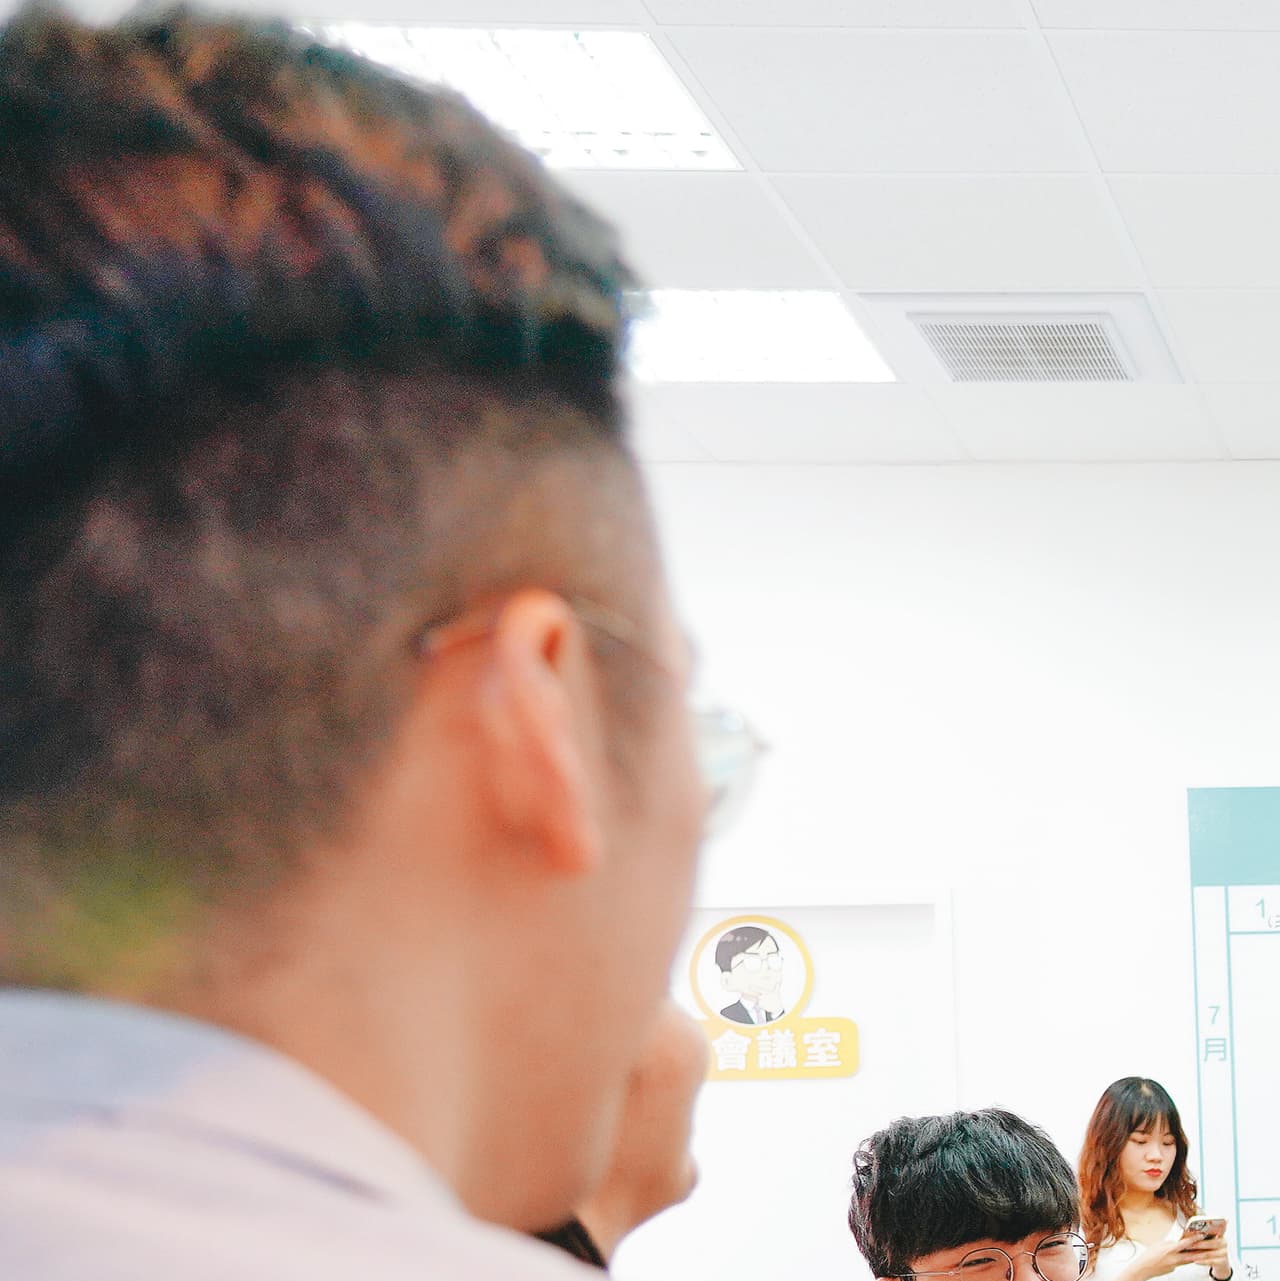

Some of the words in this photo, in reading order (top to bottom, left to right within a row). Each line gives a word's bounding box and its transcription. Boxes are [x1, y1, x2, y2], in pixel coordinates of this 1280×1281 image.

[1255, 898, 1267, 918] 1
[711, 1027, 843, 1073] 會議室
[1265, 1214, 1278, 1235] 1
